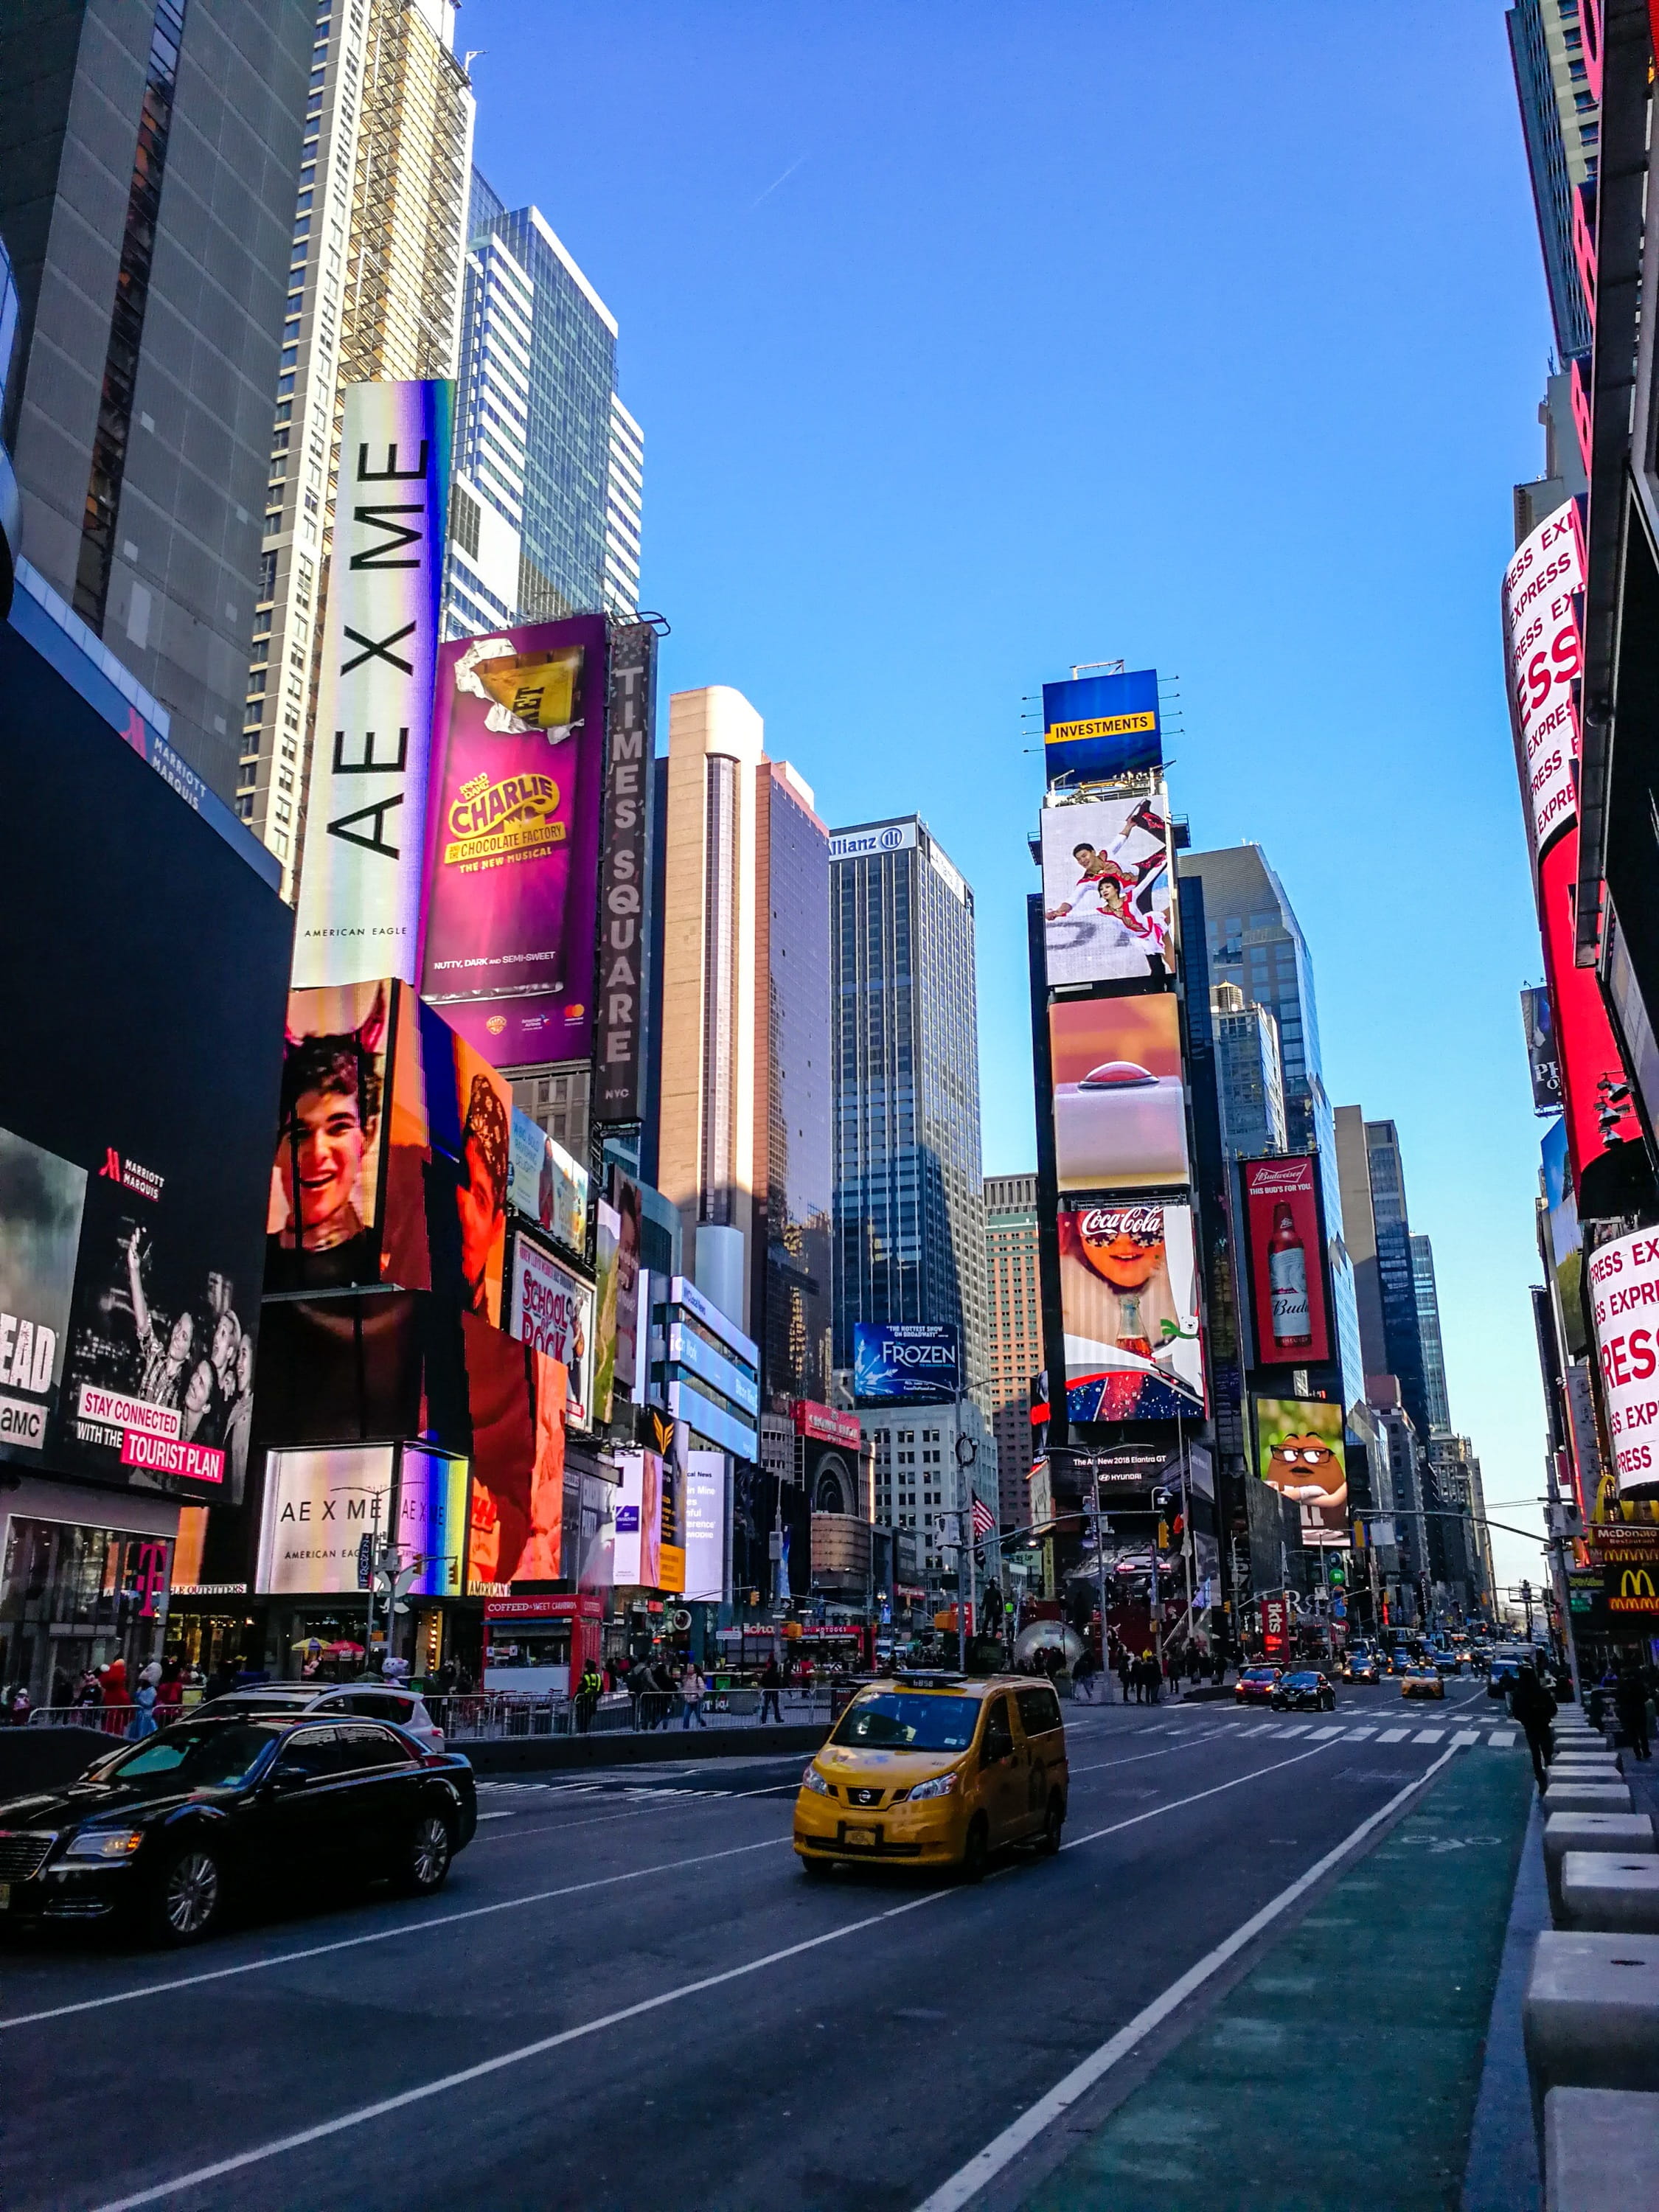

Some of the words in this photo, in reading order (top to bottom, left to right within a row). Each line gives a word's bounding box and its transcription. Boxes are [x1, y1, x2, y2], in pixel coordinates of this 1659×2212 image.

[1512, 552, 1571, 631] EXPRESS
[341, 621, 416, 675] X
[1056, 715, 1148, 738] INVESTMENTS
[612, 666, 644, 830] TIMES
[154, 737, 206, 798] MARRIOTT
[153, 755, 199, 810] MARQUIS
[452, 776, 552, 833] CHARLIE
[461, 833, 519, 857] CHOCOLATE
[523, 826, 563, 844] FACTORY
[459, 862, 481, 873] THE
[481, 857, 504, 869] NEW
[507, 846, 552, 863] MUSICAL
[305, 928, 365, 938] AMERICAN
[372, 926, 408, 936] EAGLE
[434, 959, 464, 970] NUTTY,
[464, 958, 488, 967] DARK
[502, 951, 555, 964] SEMI-SWEET
[607, 849, 640, 1062] SQUARE
[605, 1089, 629, 1099] NYC
[123, 1173, 159, 1199] MARQUIS
[125, 1159, 164, 1188] MARRIOTT
[1256, 1170, 1301, 1181] Budweiser
[1265, 1186, 1283, 1194] BUD'S
[1284, 1184, 1297, 1192] FOR
[1082, 1206, 1164, 1235] Coca-Cola
[522, 1269, 567, 1328] SCHOOL
[883, 1341, 956, 1368] FROZEN
[85, 1392, 113, 1417] STAY
[114, 1401, 178, 1434] CONNECTED
[77, 1422, 102, 1445] WITH
[104, 1428, 123, 1448] THE
[128, 1433, 186, 1471] TOURIST
[187, 1452, 220, 1478] PLAN
[1131, 1455, 1155, 1464] Elantra
[1156, 1455, 1166, 1463] GT
[698, 1486, 715, 1495] Mine
[280, 1501, 312, 1522] AE
[321, 1500, 336, 1520] X
[347, 1499, 382, 1520] ME
[402, 1499, 416, 1520] AE
[285, 1549, 336, 1559] AMERICAN
[360, 1539, 369, 1587] FROZEN
[187, 1584, 244, 1595] OUTFITTERS
[487, 1603, 529, 1612] COFFEED
[533, 1602, 550, 1610] SWEET
[1267, 1603, 1283, 1633] tkts
